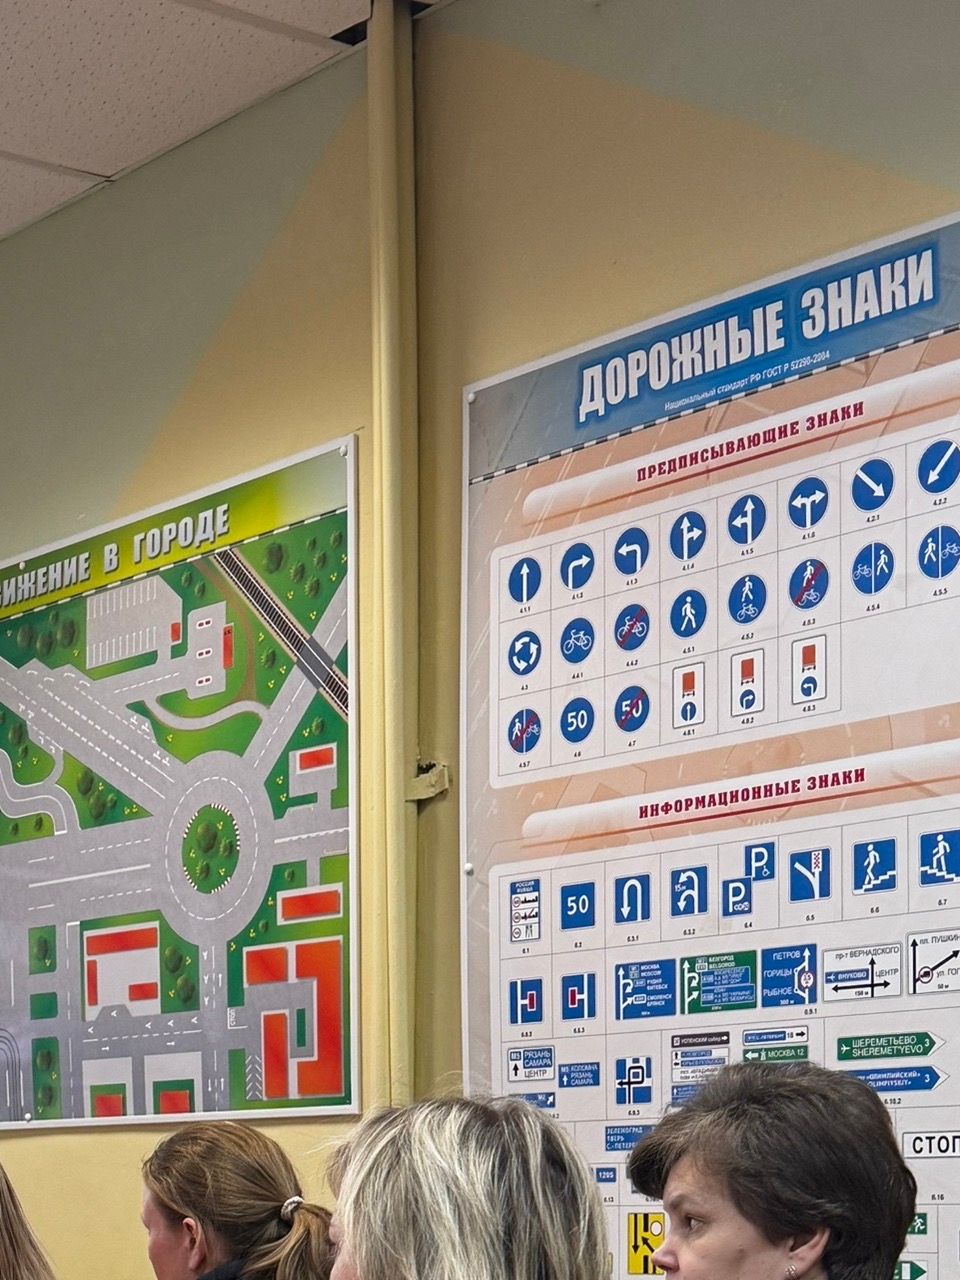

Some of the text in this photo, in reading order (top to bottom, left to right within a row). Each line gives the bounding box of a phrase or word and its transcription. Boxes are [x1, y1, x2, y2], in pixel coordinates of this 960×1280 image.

[579, 249, 934, 422] ДОРОЖНЫЕ ЗНАКИ
[762, 366, 783, 379] ГОСТ
[637, 401, 864, 482] ПРЕДПИСЫВАЮЩИЕ ЗНАКИ
[103, 542, 119, 574] В
[133, 503, 229, 564] ГОРОДЕ
[567, 709, 588, 731] 50
[639, 768, 865, 819] ИНФОРМАЦИОННЫЕ ЗНАКИ
[567, 894, 589, 915] 50
[772, 950, 800, 960] ПЕТРОВ
[849, 946, 899, 958] ВЕРНАДСКОГО
[763, 968, 792, 977] ГОРИЦЫ
[875, 968, 899, 978] ЦЕНТР
[763, 986, 792, 996] РЫБНОЕ
[852, 1035, 930, 1048] ШЕРЕМЕТЬЕВО 3
[524, 1050, 551, 1058] РЯЗАНЬ
[768, 1049, 795, 1057] МОСКВА
[524, 1059, 552, 1067] САМАРА
[524, 1070, 547, 1078] ЦЕНТР
[925, 1075, 930, 1083] 3
